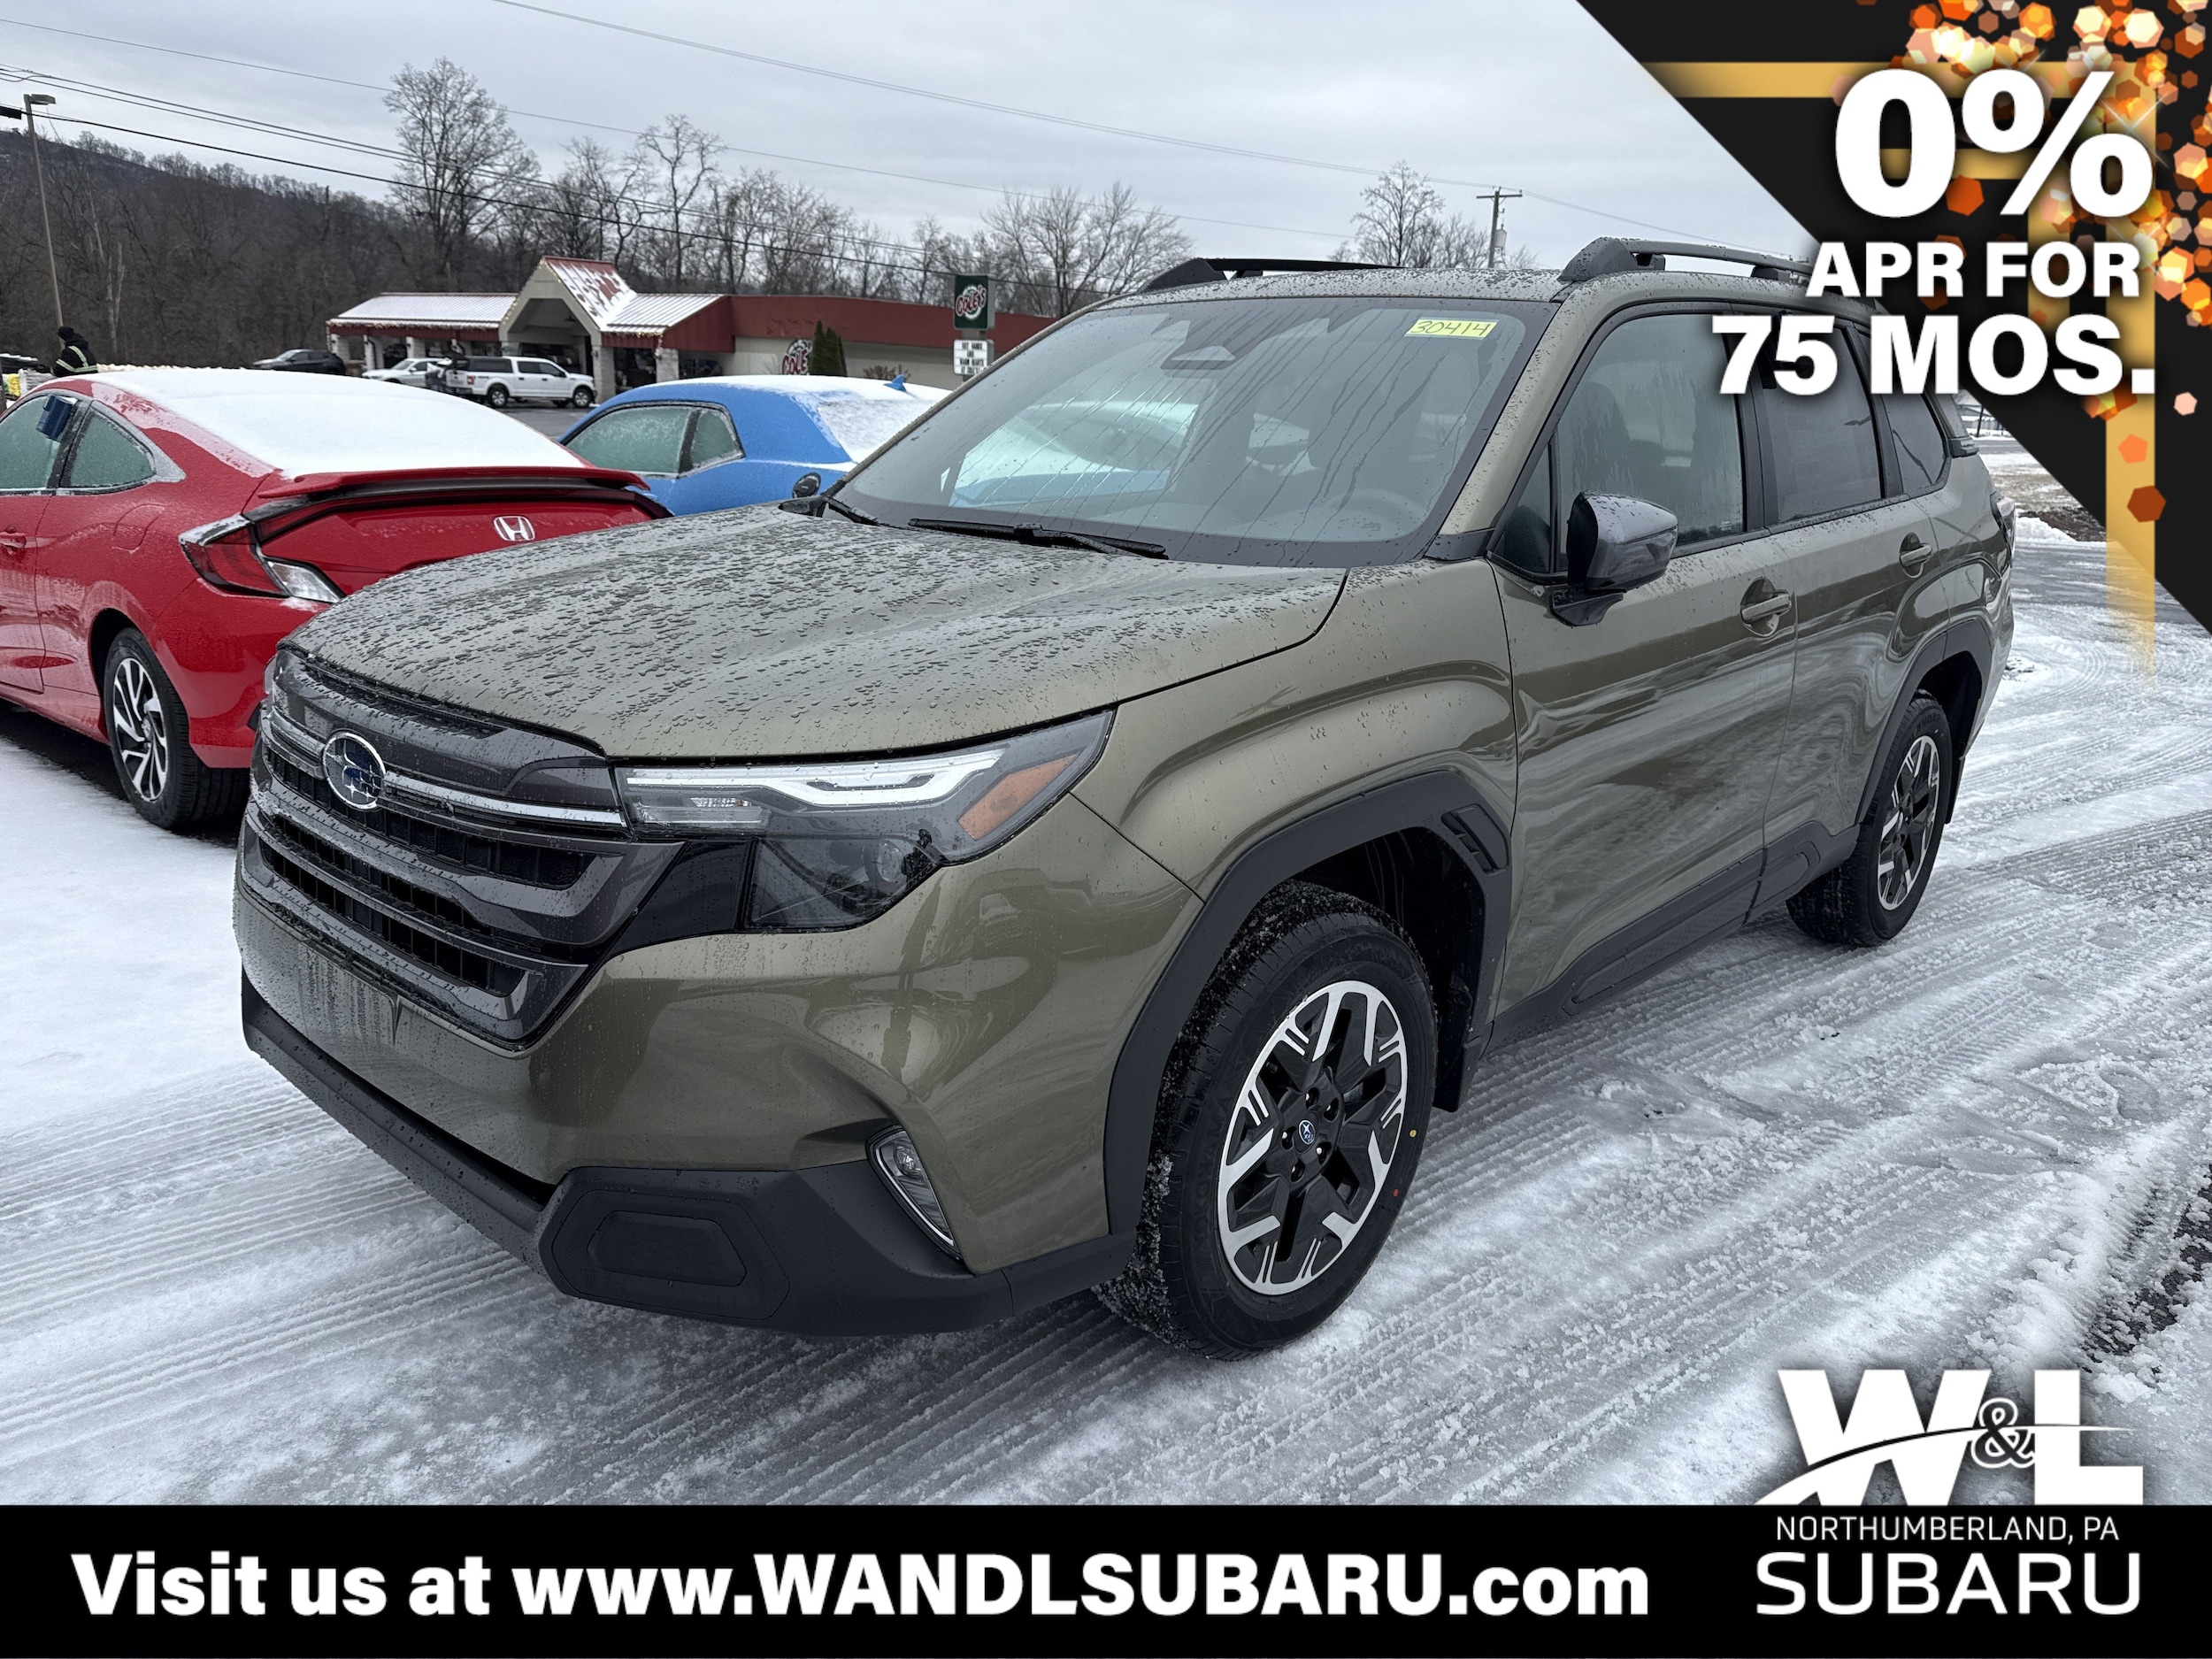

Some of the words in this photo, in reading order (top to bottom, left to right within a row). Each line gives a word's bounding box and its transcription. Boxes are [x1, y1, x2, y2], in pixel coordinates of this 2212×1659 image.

[956, 285, 986, 317] COLE'S
[1410, 320, 1491, 336] 30414
[781, 341, 812, 375] COLE'
